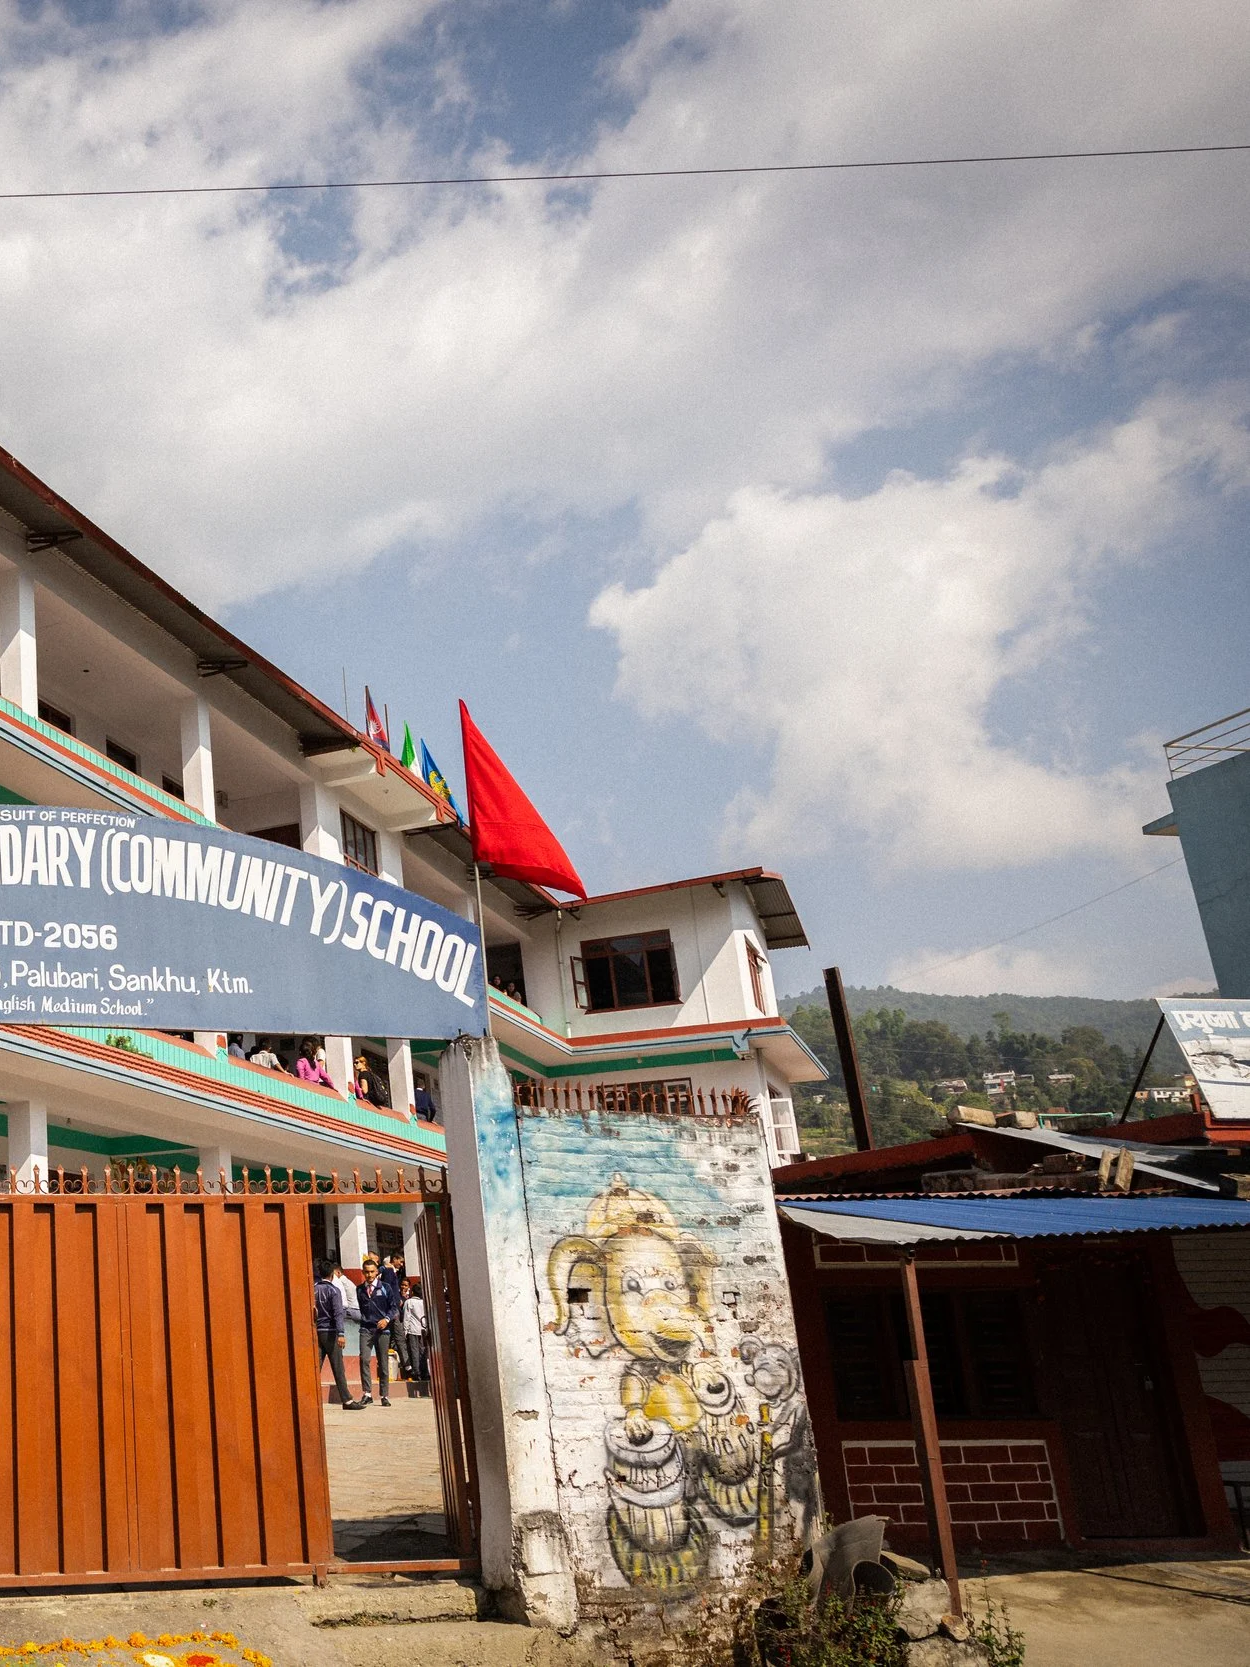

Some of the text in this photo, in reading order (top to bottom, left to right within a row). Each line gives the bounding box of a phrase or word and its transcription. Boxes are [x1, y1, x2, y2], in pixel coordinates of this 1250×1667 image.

[39, 811, 57, 820] OF
[100, 828, 349, 945] (COMMUNITY)
[342, 892, 477, 1008] SCHOOL
[11, 960, 104, 992] Palubari,
[108, 964, 201, 996] Sankhu,
[207, 968, 254, 994] Ktm.
[41, 995, 98, 1015] Medium
